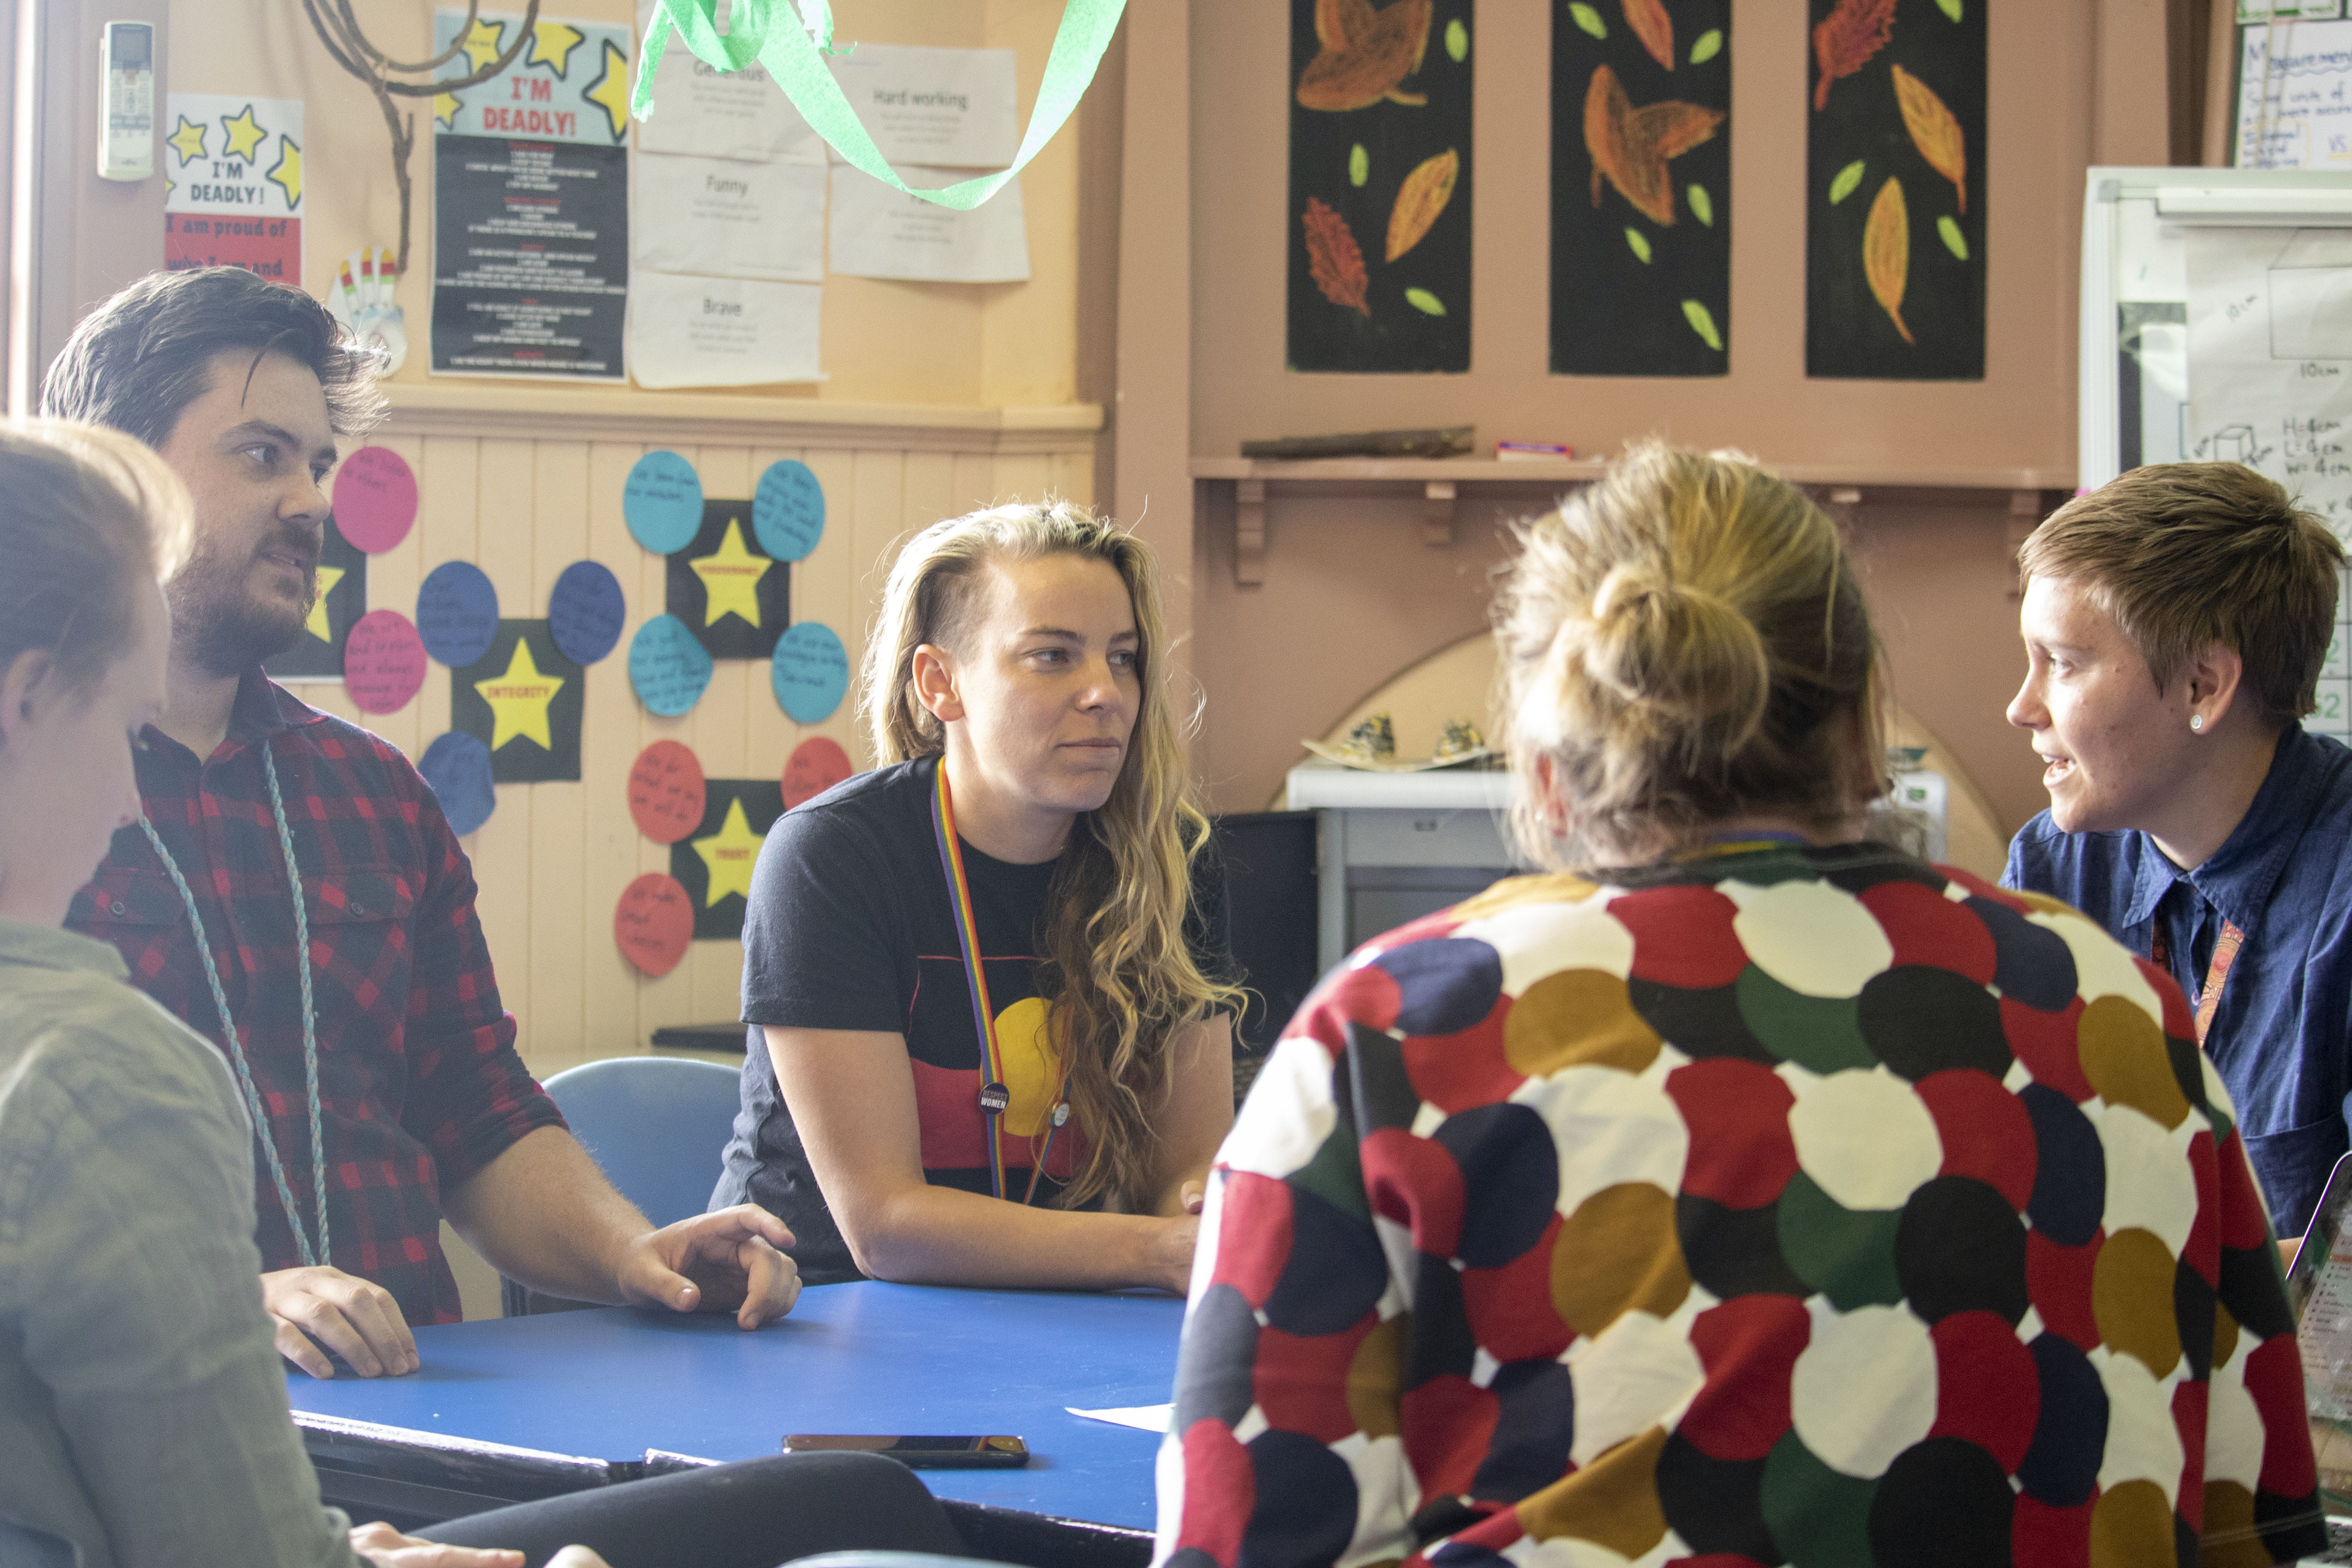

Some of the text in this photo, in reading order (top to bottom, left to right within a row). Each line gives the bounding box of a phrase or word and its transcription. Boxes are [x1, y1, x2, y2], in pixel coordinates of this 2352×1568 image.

[693, 57, 765, 82] Geous
[511, 76, 551, 102] I'M
[912, 90, 968, 112] working
[483, 107, 576, 135] DEADLY!
[212, 161, 243, 179] I'M
[191, 184, 264, 205] DEADLY!
[706, 174, 749, 197] Funny
[166, 214, 287, 239] I am proud of
[252, 258, 283, 276] and
[703, 296, 743, 317] Brave
[487, 686, 550, 699] INTEGRITY
[981, 1097, 1006, 1110] WOMEN
[983, 1090, 1009, 1102] RESPECT
